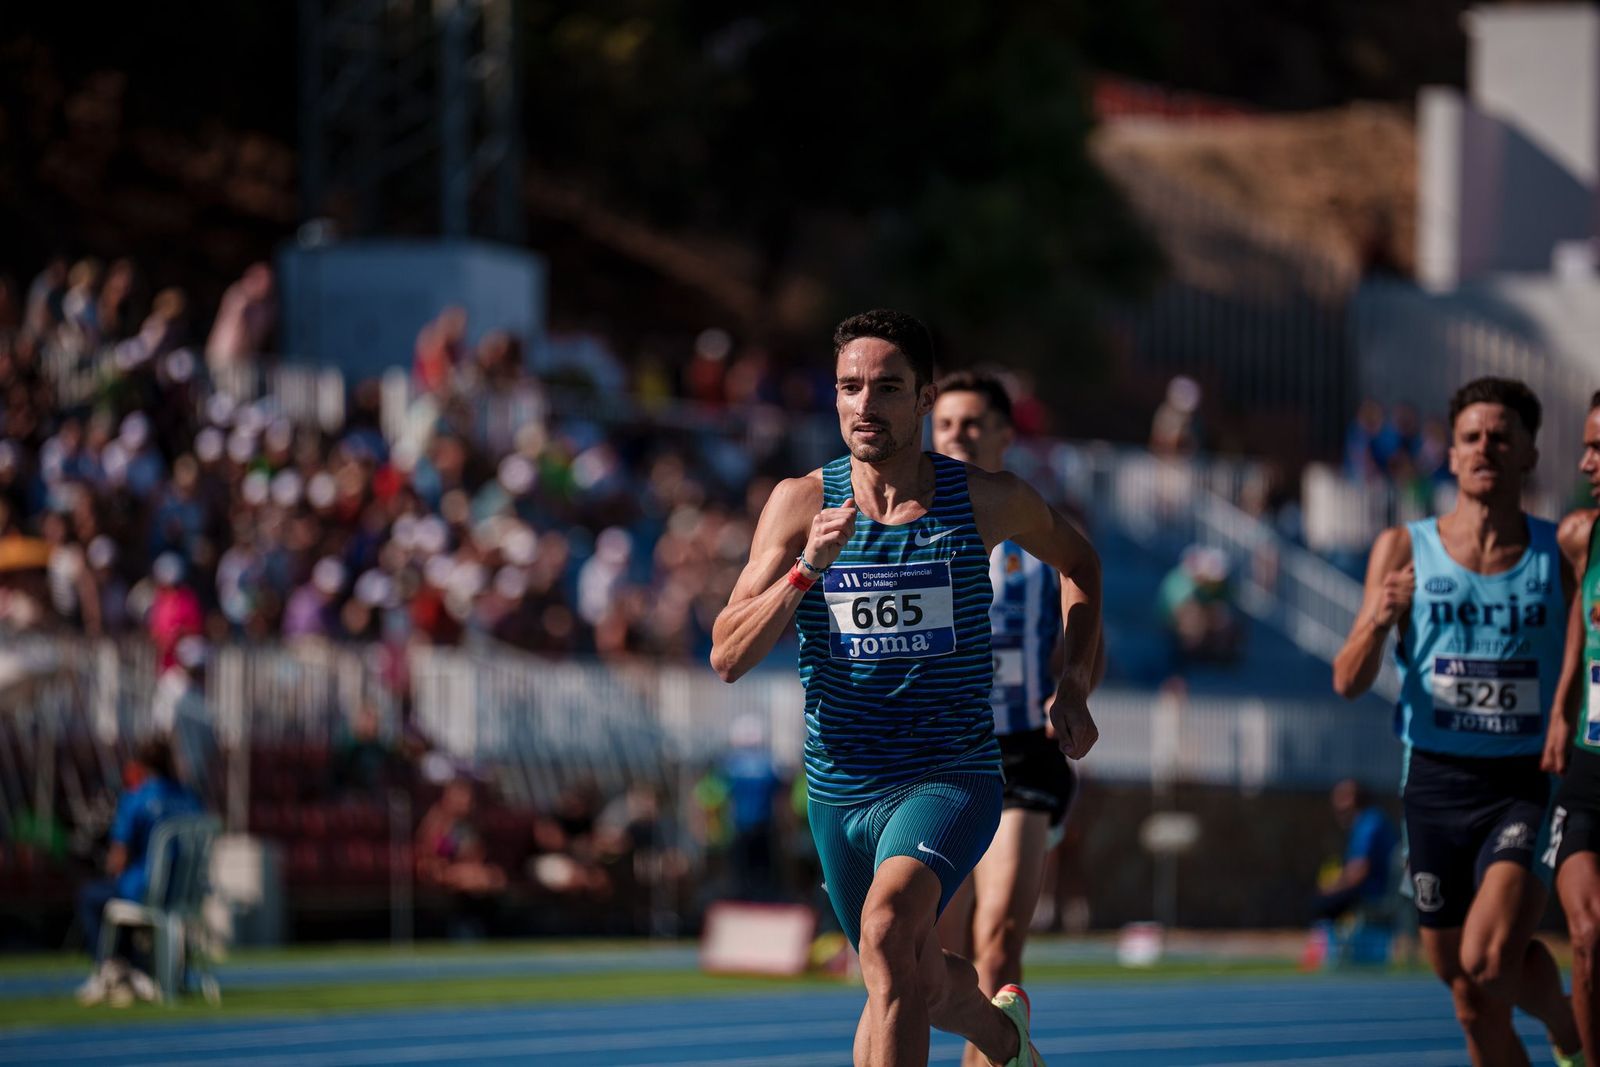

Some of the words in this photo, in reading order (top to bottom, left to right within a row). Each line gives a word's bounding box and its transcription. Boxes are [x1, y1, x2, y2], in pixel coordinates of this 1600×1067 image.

[862, 571, 899, 580] Diputación
[900, 569, 932, 578] Provincial
[852, 594, 923, 629] 665
[1430, 595, 1547, 635] nerja
[1457, 682, 1518, 710] 526
